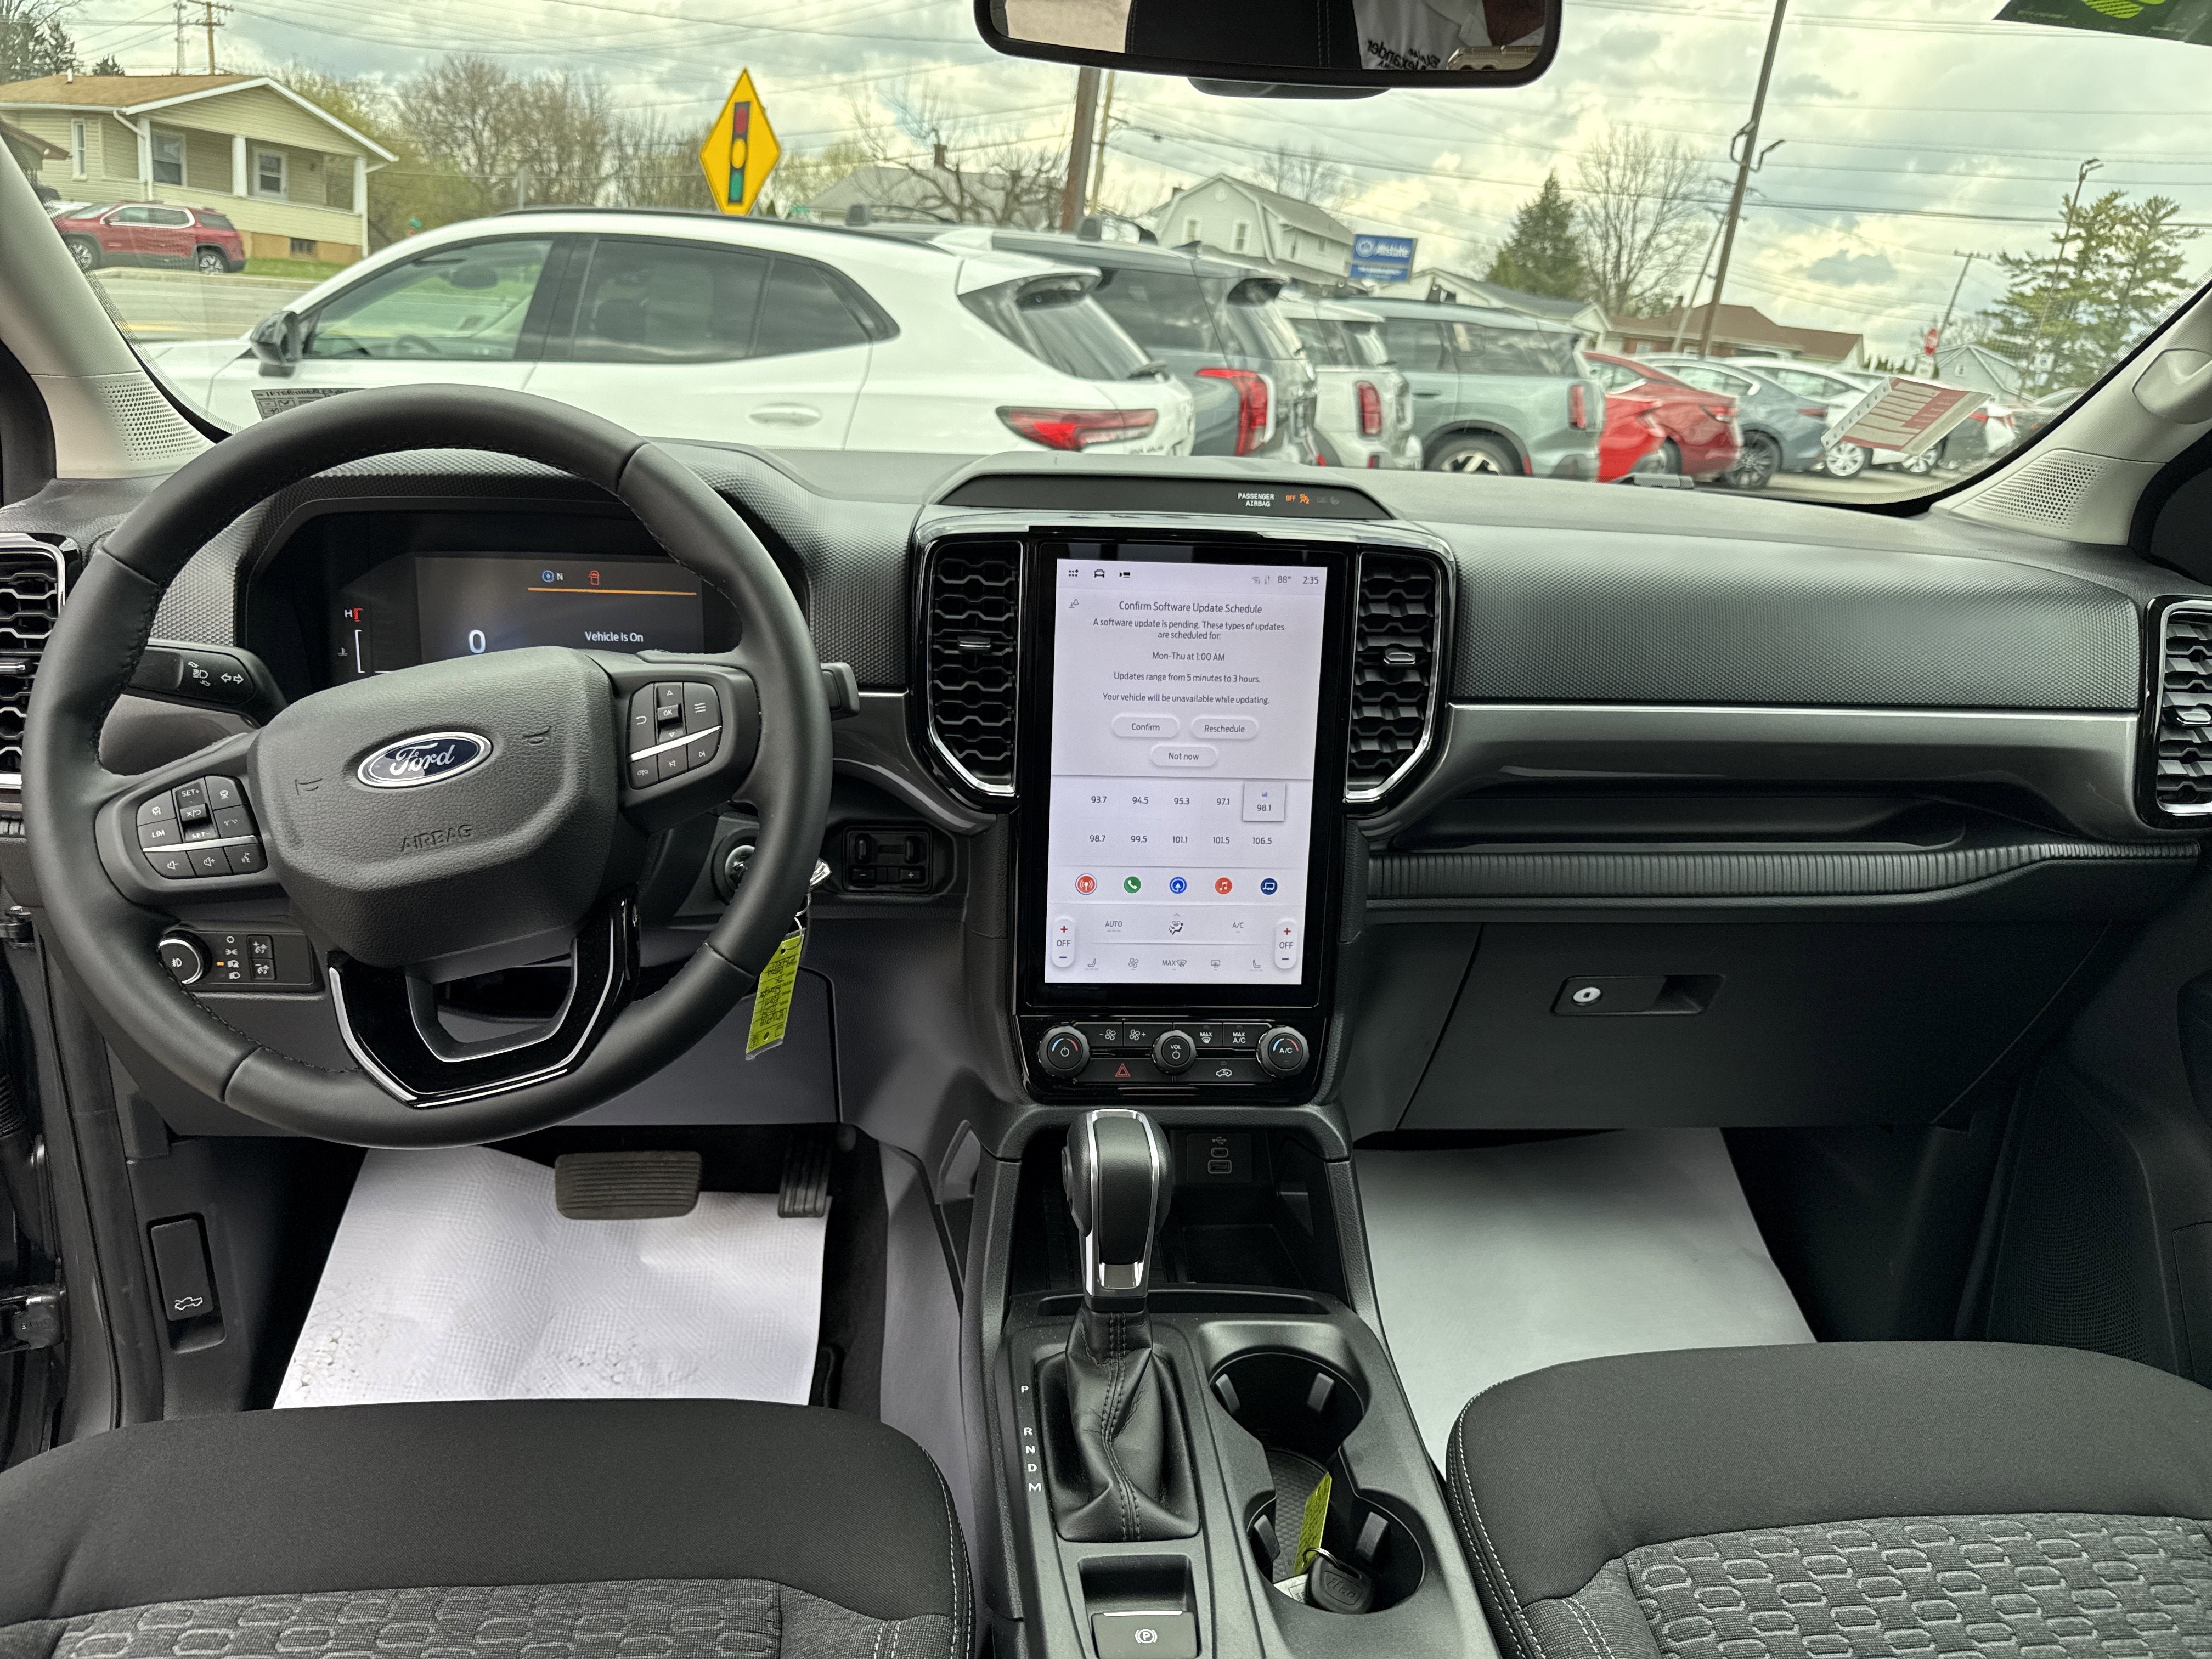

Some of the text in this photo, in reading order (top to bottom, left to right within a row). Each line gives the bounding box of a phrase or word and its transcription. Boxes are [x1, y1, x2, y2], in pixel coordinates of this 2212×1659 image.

[556, 572, 563, 581] N
[1277, 575, 1319, 585] 88° 2:35
[1119, 601, 1262, 614] Confirm Software Update Schedule
[345, 609, 353, 618] H
[1093, 618, 1099, 626] A
[1100, 618, 1133, 627] software
[1134, 619, 1161, 629] update
[1161, 619, 1167, 628] is
[1201, 620, 1224, 629] These
[1224, 622, 1245, 631] types
[1246, 622, 1255, 630] of
[1255, 622, 1285, 631] updates
[584, 631, 644, 642] Vehicle is On
[1171, 630, 1208, 640] scheduled
[1209, 631, 1221, 640] for:
[469, 629, 487, 654] 0
[1152, 651, 1186, 660] Mon-Thu
[1196, 652, 1211, 661] 1:00
[1212, 653, 1225, 661] AM
[1114, 671, 1145, 681] Updates
[1167, 673, 1186, 681] from
[1187, 673, 1192, 681] 5
[1193, 674, 1222, 682] minutes
[1233, 674, 1238, 682] 3
[1238, 674, 1261, 683] hours.
[1102, 692, 1270, 706] Your vehicle will be unavailable while updating.
[1131, 723, 1160, 731] Confirm
[1204, 724, 1245, 733] Reschedule
[390, 742, 456, 775] Ford
[1168, 752, 1182, 760] Not
[1091, 795, 1107, 804] 93.7
[1216, 798, 1230, 806] 97.1
[1256, 804, 1272, 812] 98.1
[151, 829, 165, 838] LIM
[401, 824, 472, 852] AIRBAG
[1090, 834, 1106, 843] 98.7
[1130, 835, 1147, 843] 99.5
[1172, 836, 1188, 844] 101.1
[1212, 836, 1230, 844] 101.5
[1252, 837, 1272, 845] 106.5
[1020, 1385, 1029, 1393] P
[1023, 1427, 1033, 1436] R
[1025, 1445, 1036, 1454] N
[1028, 1463, 1037, 1472] D
[1028, 1482, 1042, 1492] M
